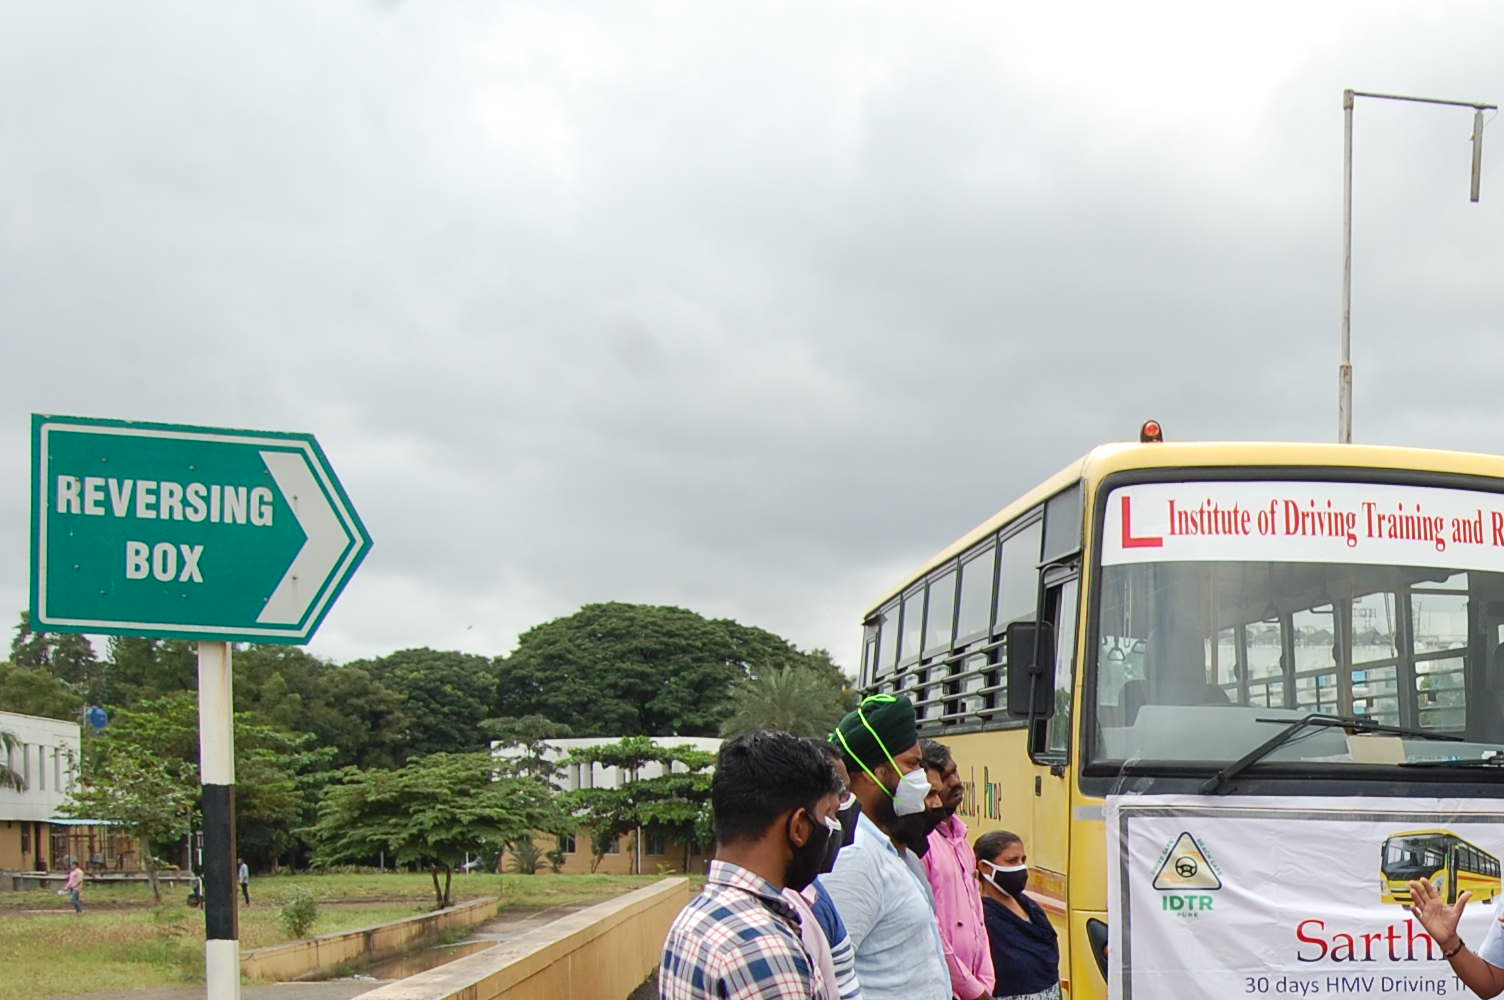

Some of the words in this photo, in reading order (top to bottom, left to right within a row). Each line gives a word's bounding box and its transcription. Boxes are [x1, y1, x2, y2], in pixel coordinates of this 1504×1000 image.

[56, 474, 274, 527] REVERSING
[1168, 498, 1251, 536] Institute
[1257, 499, 1278, 536] of
[1284, 499, 1358, 548] Driving
[1362, 502, 1446, 552] Training
[1452, 509, 1484, 545] and
[125, 540, 205, 583] BOX
[984, 766, 1002, 821] Pune
[1162, 895, 1214, 911] IDTR
[1296, 919, 1449, 962] Sarth
[1245, 976, 1269, 993] 30
[1275, 975, 1320, 1000] days
[1326, 976, 1375, 993] HMV
[1381, 975, 1447, 995] Driving
